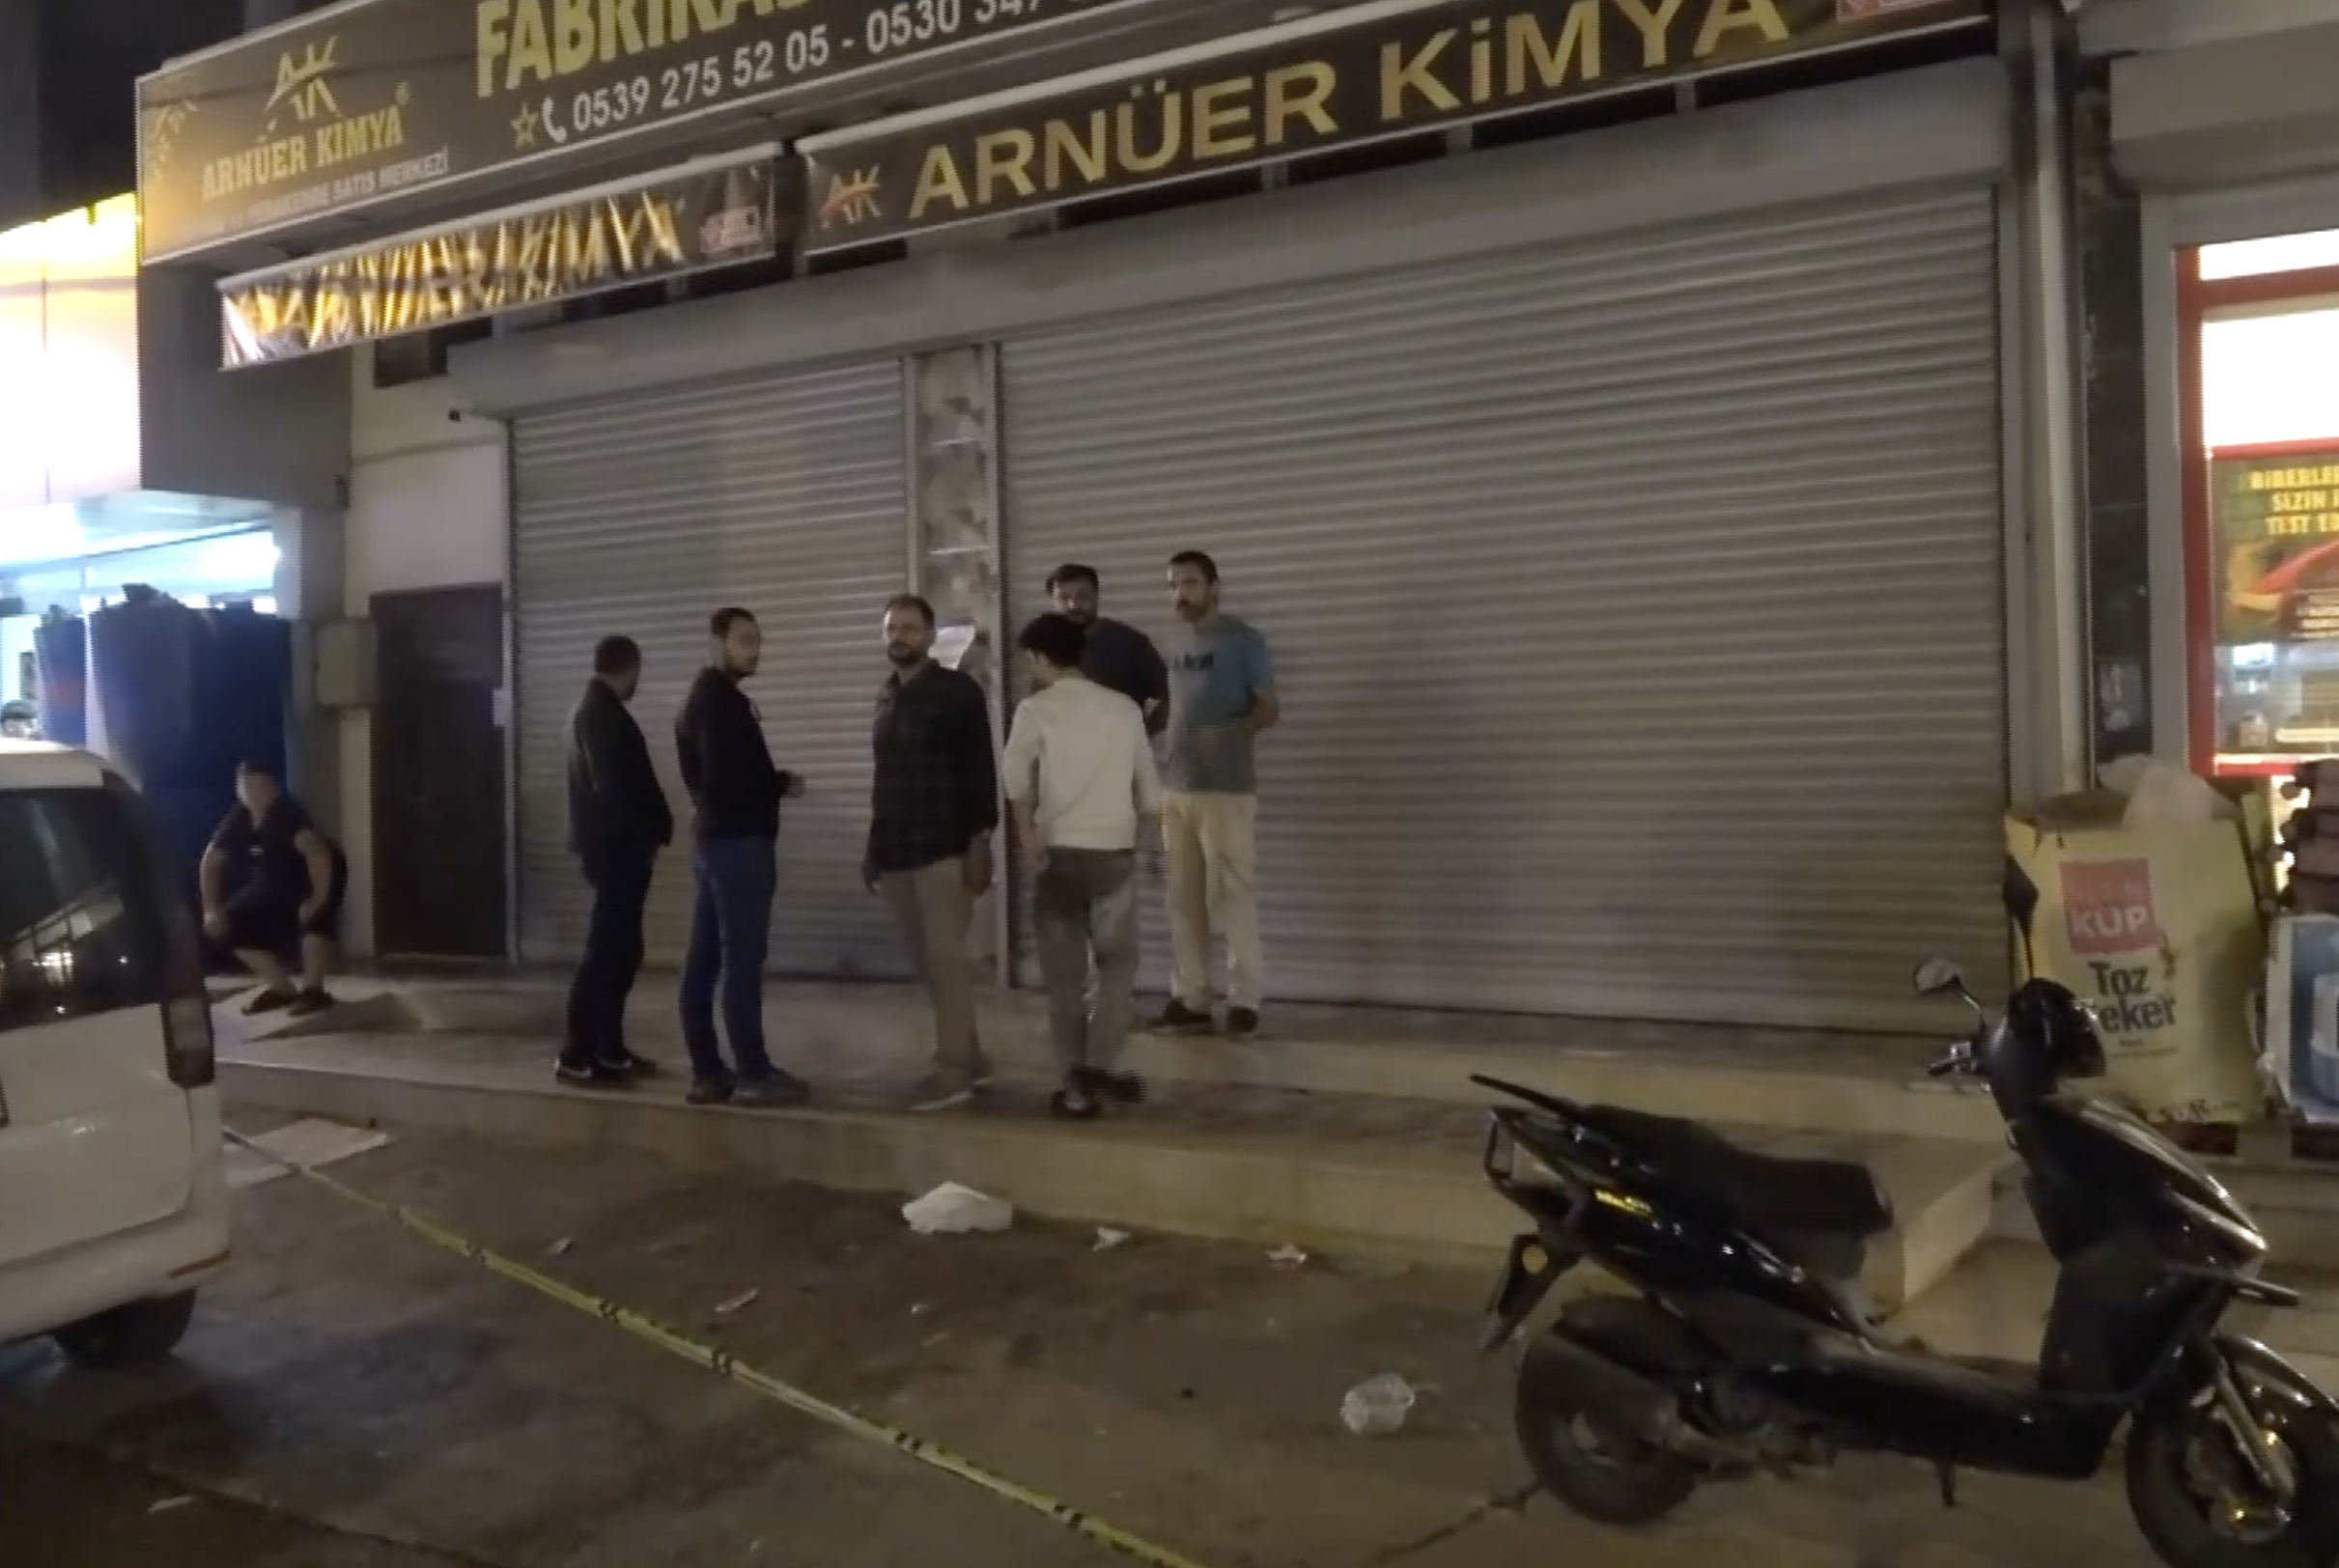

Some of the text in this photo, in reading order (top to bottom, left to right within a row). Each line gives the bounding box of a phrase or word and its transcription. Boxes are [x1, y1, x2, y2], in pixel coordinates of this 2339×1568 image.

[573, 75, 651, 132] 0539
[661, 55, 723, 110] 275
[732, 40, 774, 88] 52
[785, 23, 830, 74] 05
[866, 0, 961, 54] 0530
[907, 60, 1340, 220] ARNÜER
[2087, 962, 2151, 997] Toz
[2092, 993, 2177, 1034] eker
